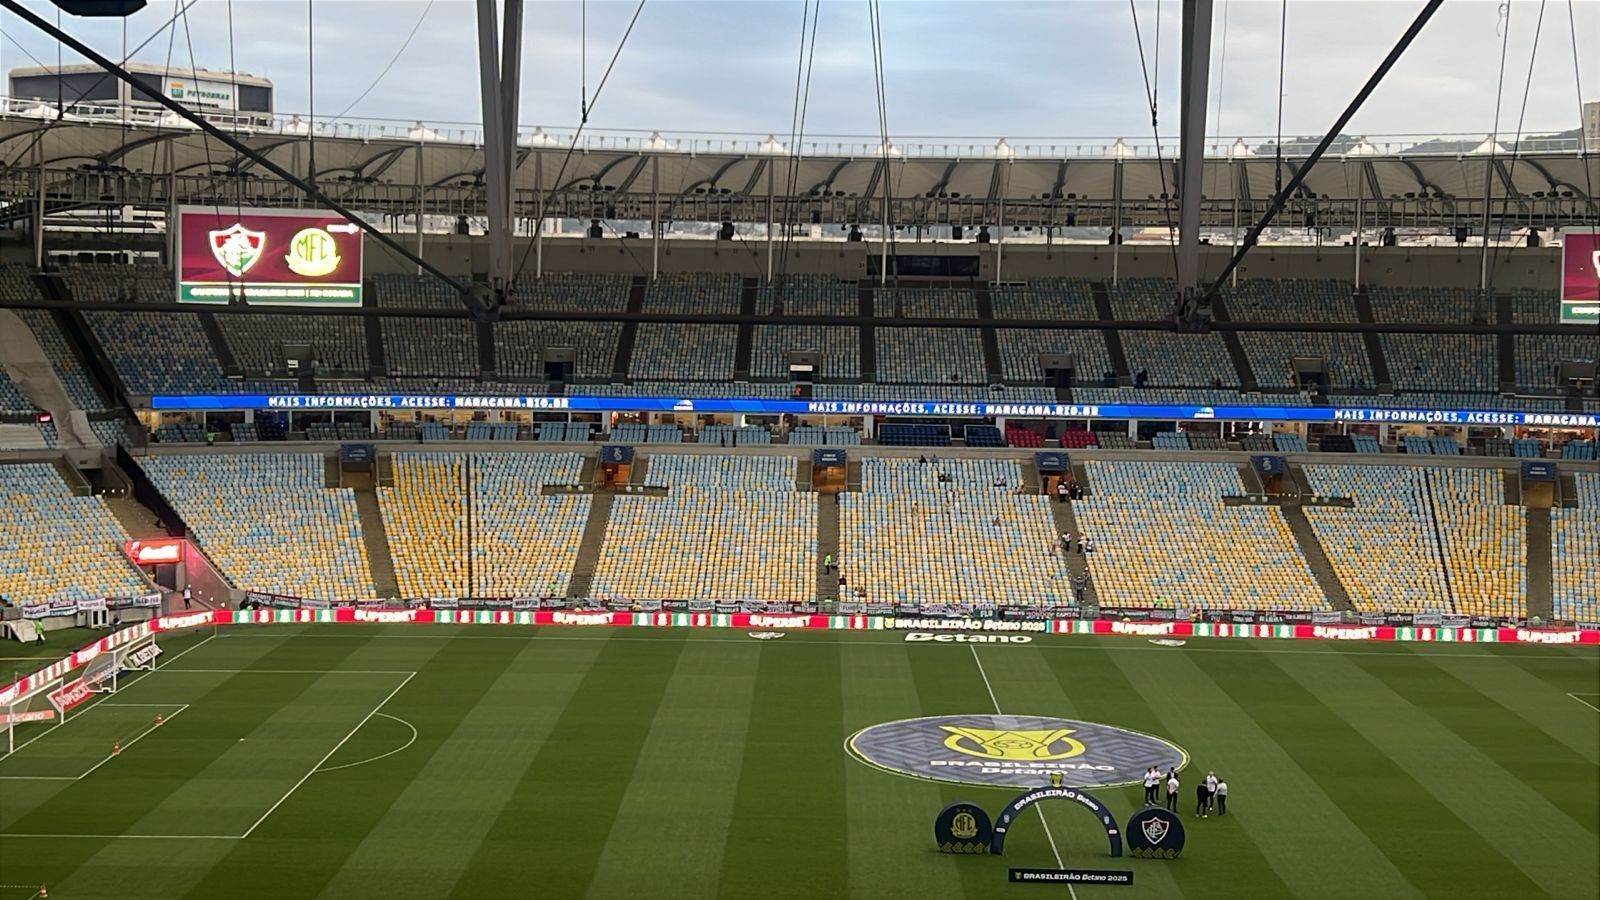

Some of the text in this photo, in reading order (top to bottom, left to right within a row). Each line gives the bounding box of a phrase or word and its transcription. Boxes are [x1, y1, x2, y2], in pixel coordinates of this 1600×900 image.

[187, 90, 230, 100] PETROBRAS
[268, 396, 299, 407] MAIS
[401, 397, 450, 408] ACESSE:
[808, 402, 838, 413] MAIS
[933, 404, 981, 414] ACESSE:
[1334, 410, 1365, 420] MAIS
[1467, 412, 1519, 424] ACESSE:
[895, 618, 982, 630] BRASILEIRÃO
[1021, 621, 1045, 632] 2025
[905, 632, 1033, 643] Betano
[1313, 625, 1377, 640] SUPERBET
[1517, 630, 1581, 643] SUPERBET
[930, 760, 1115, 771] BRASILEIRÃO
[981, 767, 1068, 775] Betano
[1014, 789, 1099, 811] BRASILEIRÃO Betano
[1023, 872, 1081, 880] BRASILEIRÃO
[1081, 873, 1107, 881] Betano
